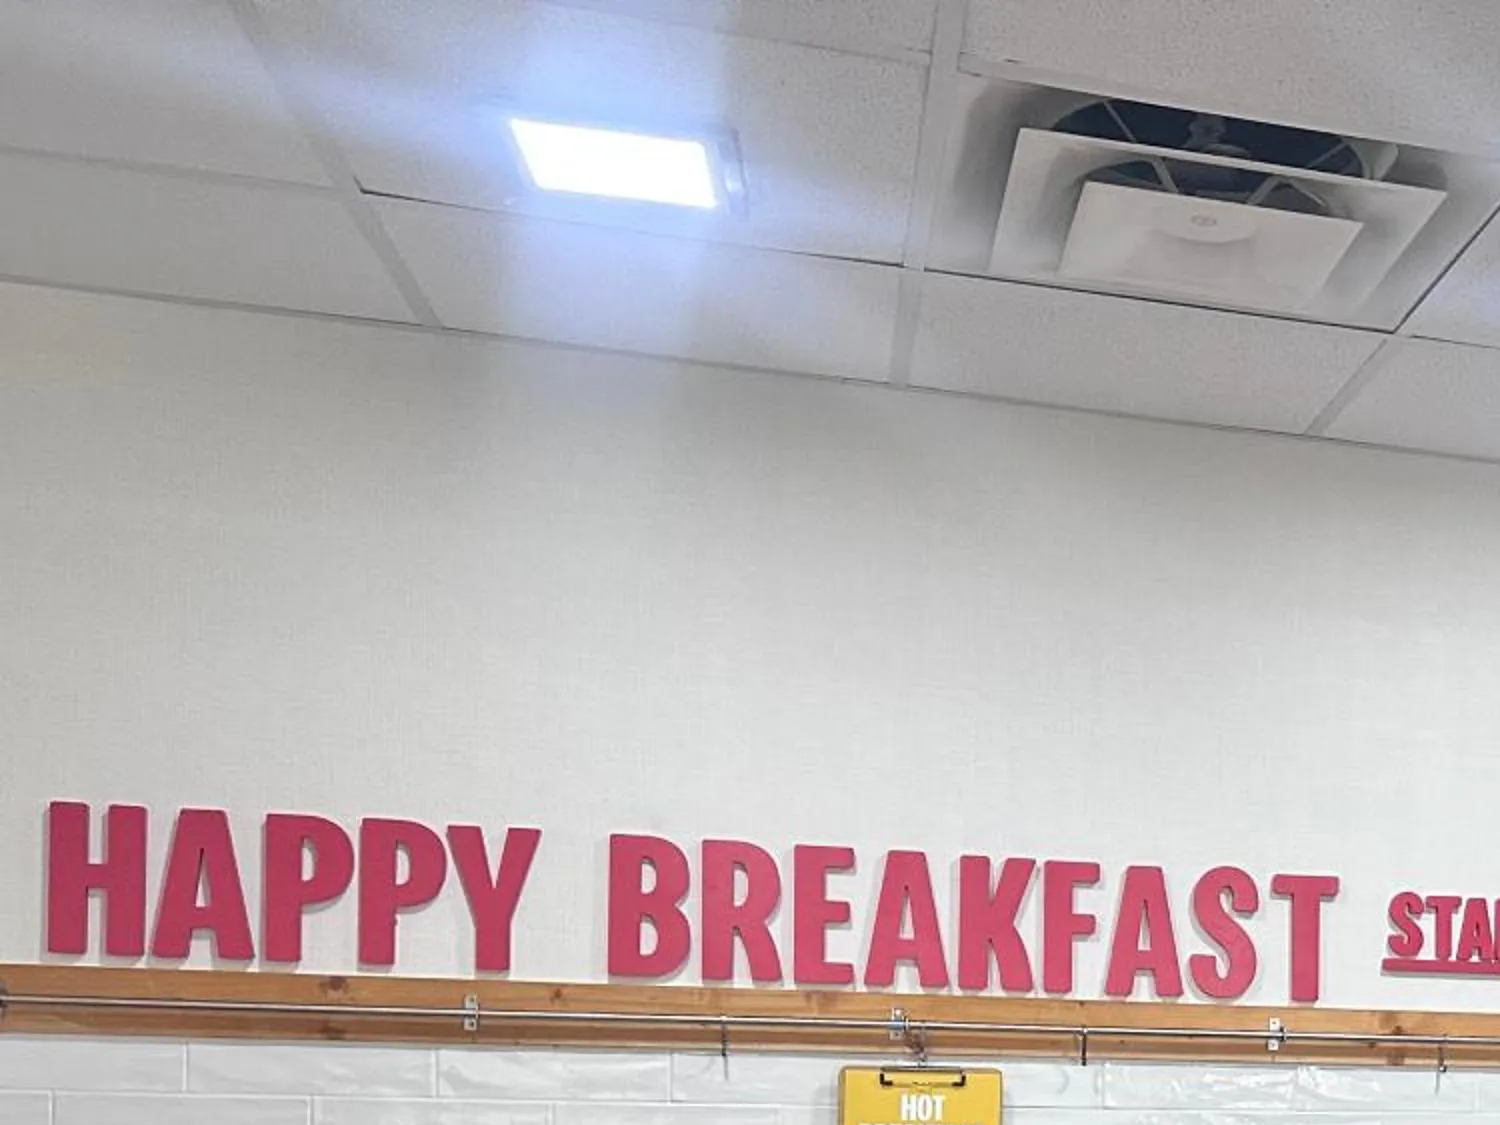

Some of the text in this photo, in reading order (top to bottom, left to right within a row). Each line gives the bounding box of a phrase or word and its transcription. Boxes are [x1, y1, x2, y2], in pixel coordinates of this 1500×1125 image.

[48, 801, 542, 972] HAPPY
[607, 834, 1340, 1002] BREAKFAST
[901, 1094, 946, 1121] HOT
